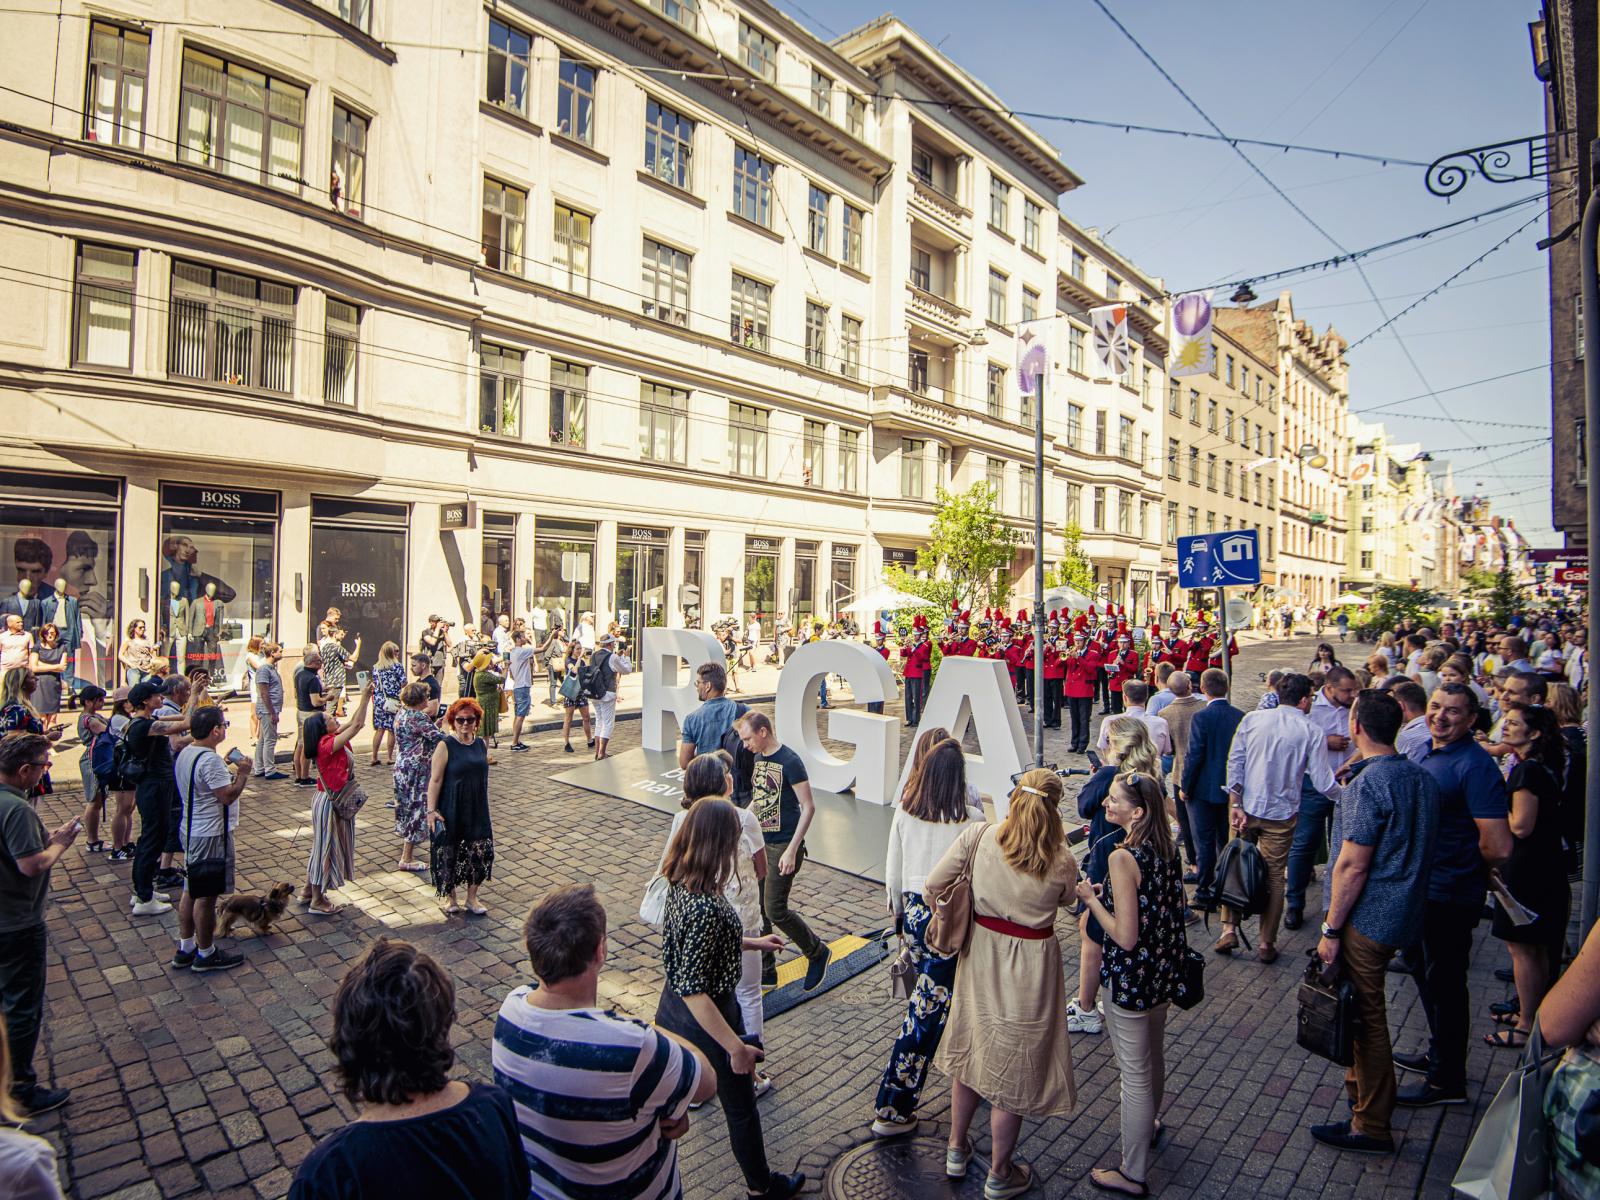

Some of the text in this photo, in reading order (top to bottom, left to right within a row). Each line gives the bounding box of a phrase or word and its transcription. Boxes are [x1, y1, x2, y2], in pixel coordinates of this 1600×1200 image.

[201, 491, 241, 505] BOSS
[446, 509, 463, 519] BOSS
[632, 528, 652, 538] BOSS
[753, 539, 769, 547] BOSS
[835, 546, 849, 554] BOSS
[341, 582, 376, 593] BOSS
